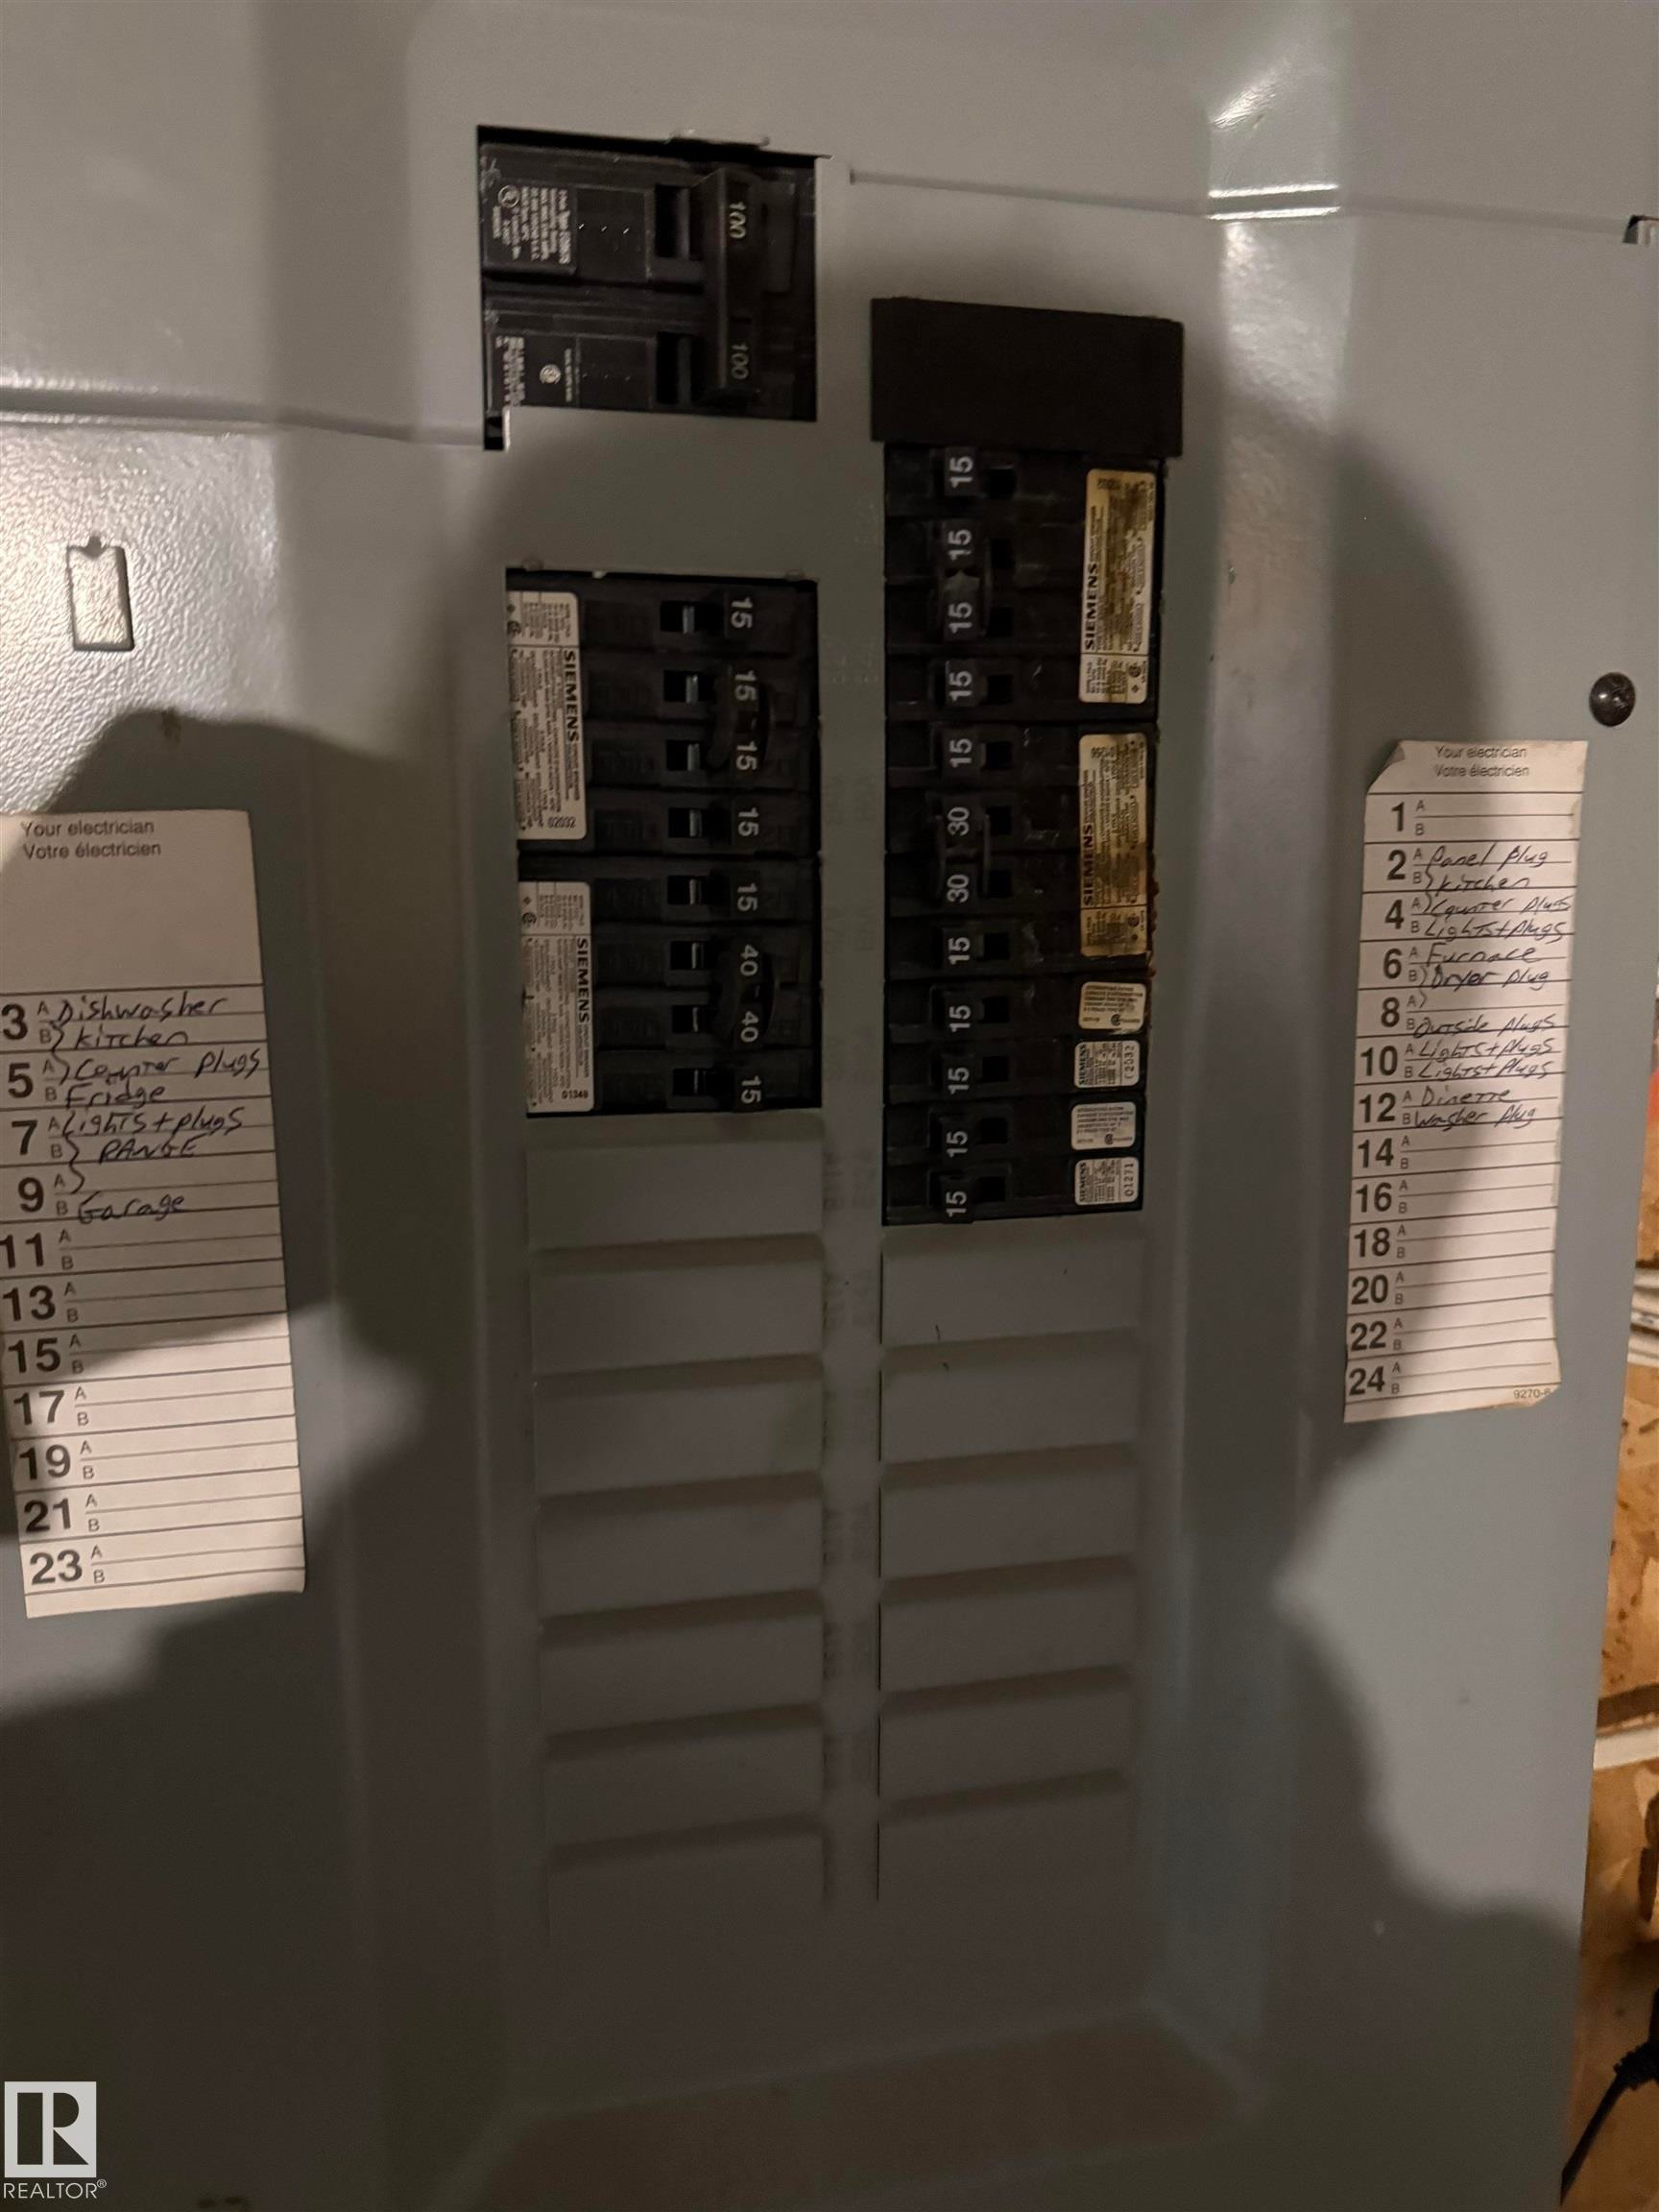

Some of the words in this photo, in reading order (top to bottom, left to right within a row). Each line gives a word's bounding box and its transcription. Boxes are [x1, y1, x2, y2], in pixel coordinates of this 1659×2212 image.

[728, 201, 747, 239] 100
[731, 344, 749, 380] 100
[950, 456, 974, 489] 15
[948, 529, 972, 561] 15
[731, 596, 754, 629] 15
[948, 602, 973, 635] 15
[1085, 563, 1098, 651] SIEMENS
[564, 650, 580, 742] SIEMENS
[734, 669, 757, 702] 15
[949, 670, 973, 702] 15
[735, 740, 757, 771] 15
[950, 738, 973, 768] 15
[1436, 745, 1464, 757] Your
[1467, 748, 1527, 757] electrician
[1434, 764, 1466, 777] Votre
[1471, 764, 1529, 777] électricien
[1392, 802, 1404, 831] 1
[1416, 800, 1425, 811] A
[21, 821, 61, 836] Your
[68, 820, 154, 835] electrician
[737, 807, 759, 836] 15
[948, 806, 970, 836] 30
[1415, 823, 1424, 835] B
[22, 844, 69, 859] Votre
[76, 842, 161, 857] électricien
[1413, 848, 1422, 859] A
[1082, 823, 1093, 906] SIEMENS
[1387, 850, 1406, 880] 2
[947, 875, 970, 903] 30
[1413, 872, 1421, 883] B
[736, 882, 758, 911] 15
[1411, 899, 1421, 908] A
[1385, 900, 1404, 929] 4
[1411, 921, 1419, 933] B
[739, 944, 759, 976] 40
[949, 937, 971, 966] 15
[1383, 949, 1402, 979] 6
[1409, 947, 1418, 957] A
[1428, 942, 1541, 967] Furnace
[576, 938, 590, 1023] SIEMENS
[1408, 970, 1417, 981] B
[37, 1002, 49, 1015] A
[1382, 998, 1400, 1027] 8
[1407, 995, 1416, 1006] A
[2, 1004, 28, 1041] 3
[740, 1010, 759, 1043] 40
[950, 1005, 972, 1033] 15
[1407, 1018, 1415, 1030] B
[39, 1029, 52, 1044] B
[1406, 1044, 1413, 1054] A
[43, 1060, 54, 1073] A
[1360, 1046, 1398, 1076] 10
[1405, 1066, 1413, 1078] B
[8, 1063, 33, 1098] 5
[740, 1074, 761, 1104] 15
[948, 1067, 970, 1094] 15
[45, 1087, 57, 1101] B
[1403, 1091, 1411, 1102] A
[1359, 1093, 1396, 1122] 12
[1403, 1113, 1411, 1124] B
[12, 1119, 37, 1155] 7
[48, 1118, 60, 1131] A
[51, 1144, 62, 1158] B
[947, 1130, 968, 1158] 15
[1358, 1138, 1394, 1167] 14
[1401, 1136, 1409, 1146] A
[1401, 1158, 1408, 1169] B
[54, 1174, 65, 1188] A
[1122, 1163, 1133, 1196] 01271
[1399, 1180, 1407, 1190] A
[18, 1177, 43, 1213] 9
[78, 1191, 185, 1224] Garage
[946, 1190, 967, 1217] 15
[1356, 1183, 1392, 1213] 16
[56, 1201, 68, 1215] B
[1399, 1202, 1407, 1214] B
[59, 1229, 70, 1242] A
[1355, 1228, 1390, 1257] 18
[1398, 1225, 1406, 1236] A
[0, 1233, 43, 1269] 11
[61, 1256, 73, 1270] B
[1397, 1247, 1405, 1259] B
[64, 1282, 75, 1295] A
[1396, 1271, 1404, 1283] A
[1351, 1275, 1388, 1305] 20
[1395, 1293, 1403, 1305] B
[2, 1286, 56, 1321] 13
[67, 1309, 79, 1322] B
[1394, 1318, 1403, 1329] A
[69, 1334, 81, 1347] A
[1351, 1321, 1386, 1352] 22
[1393, 1339, 1401, 1350] B
[8, 1337, 60, 1373] 15
[72, 1359, 84, 1373] B
[1392, 1362, 1401, 1372] A
[75, 1386, 86, 1400] A
[1349, 1366, 1385, 1396] 24
[1391, 1383, 1399, 1394] B
[12, 1388, 64, 1427] 17
[77, 1412, 88, 1426] B
[81, 1440, 91, 1454] A
[17, 1443, 70, 1481] 19
[83, 1466, 94, 1479] B
[85, 1494, 97, 1506] A
[23, 1497, 70, 1534] 21
[88, 1519, 100, 1531] B
[91, 1546, 102, 1559] A
[30, 1550, 83, 1585] 23
[93, 1570, 105, 1583] B
